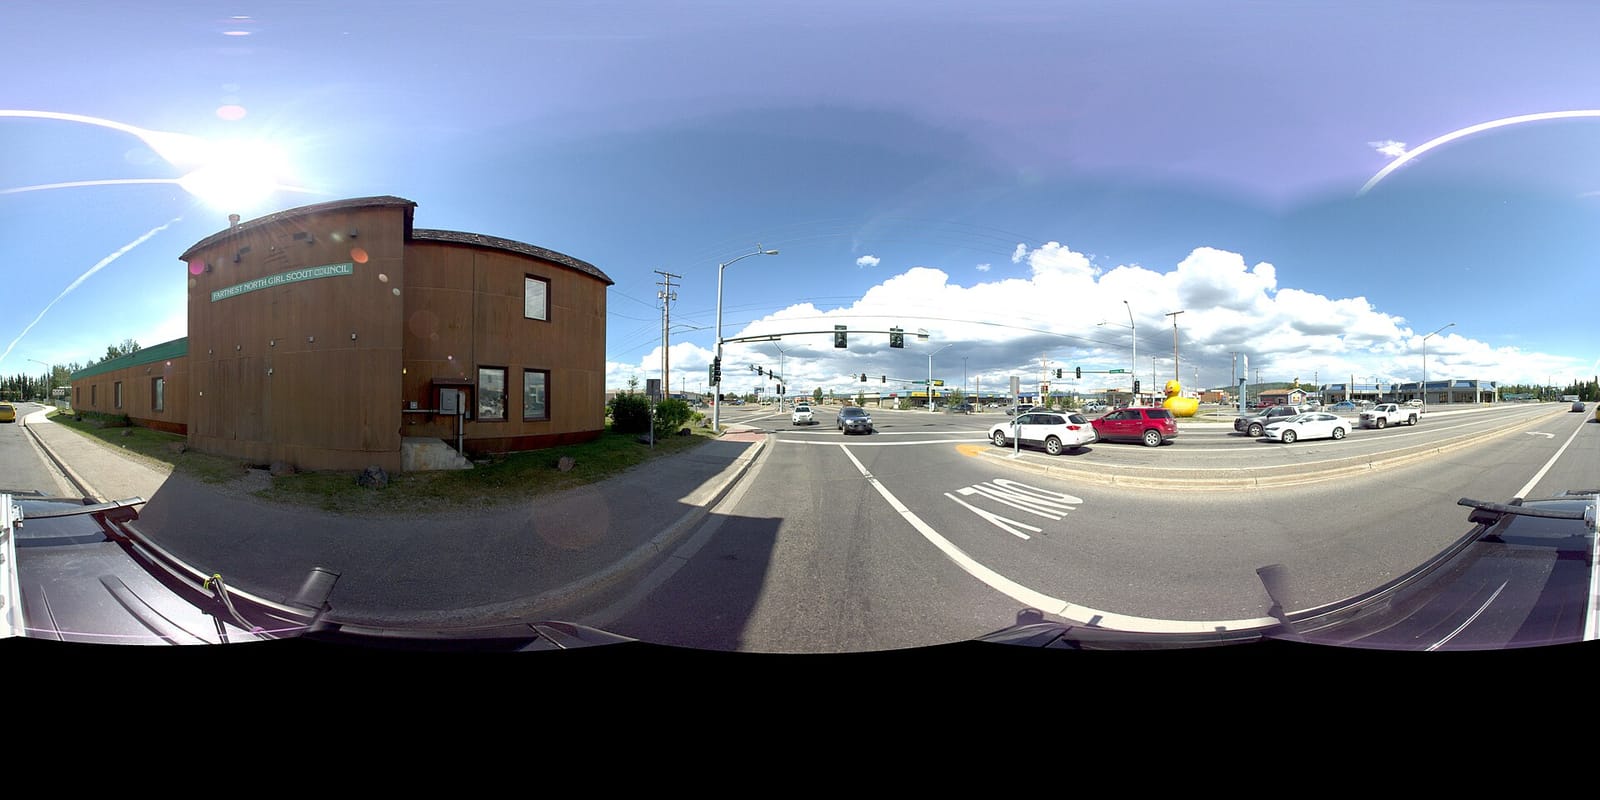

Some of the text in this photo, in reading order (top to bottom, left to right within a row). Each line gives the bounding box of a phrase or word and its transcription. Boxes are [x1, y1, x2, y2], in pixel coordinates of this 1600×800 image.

[213, 264, 350, 300] FARTHEST NORTH GIRL SCOUT COUNCIL
[944, 478, 1083, 540] ONLY
